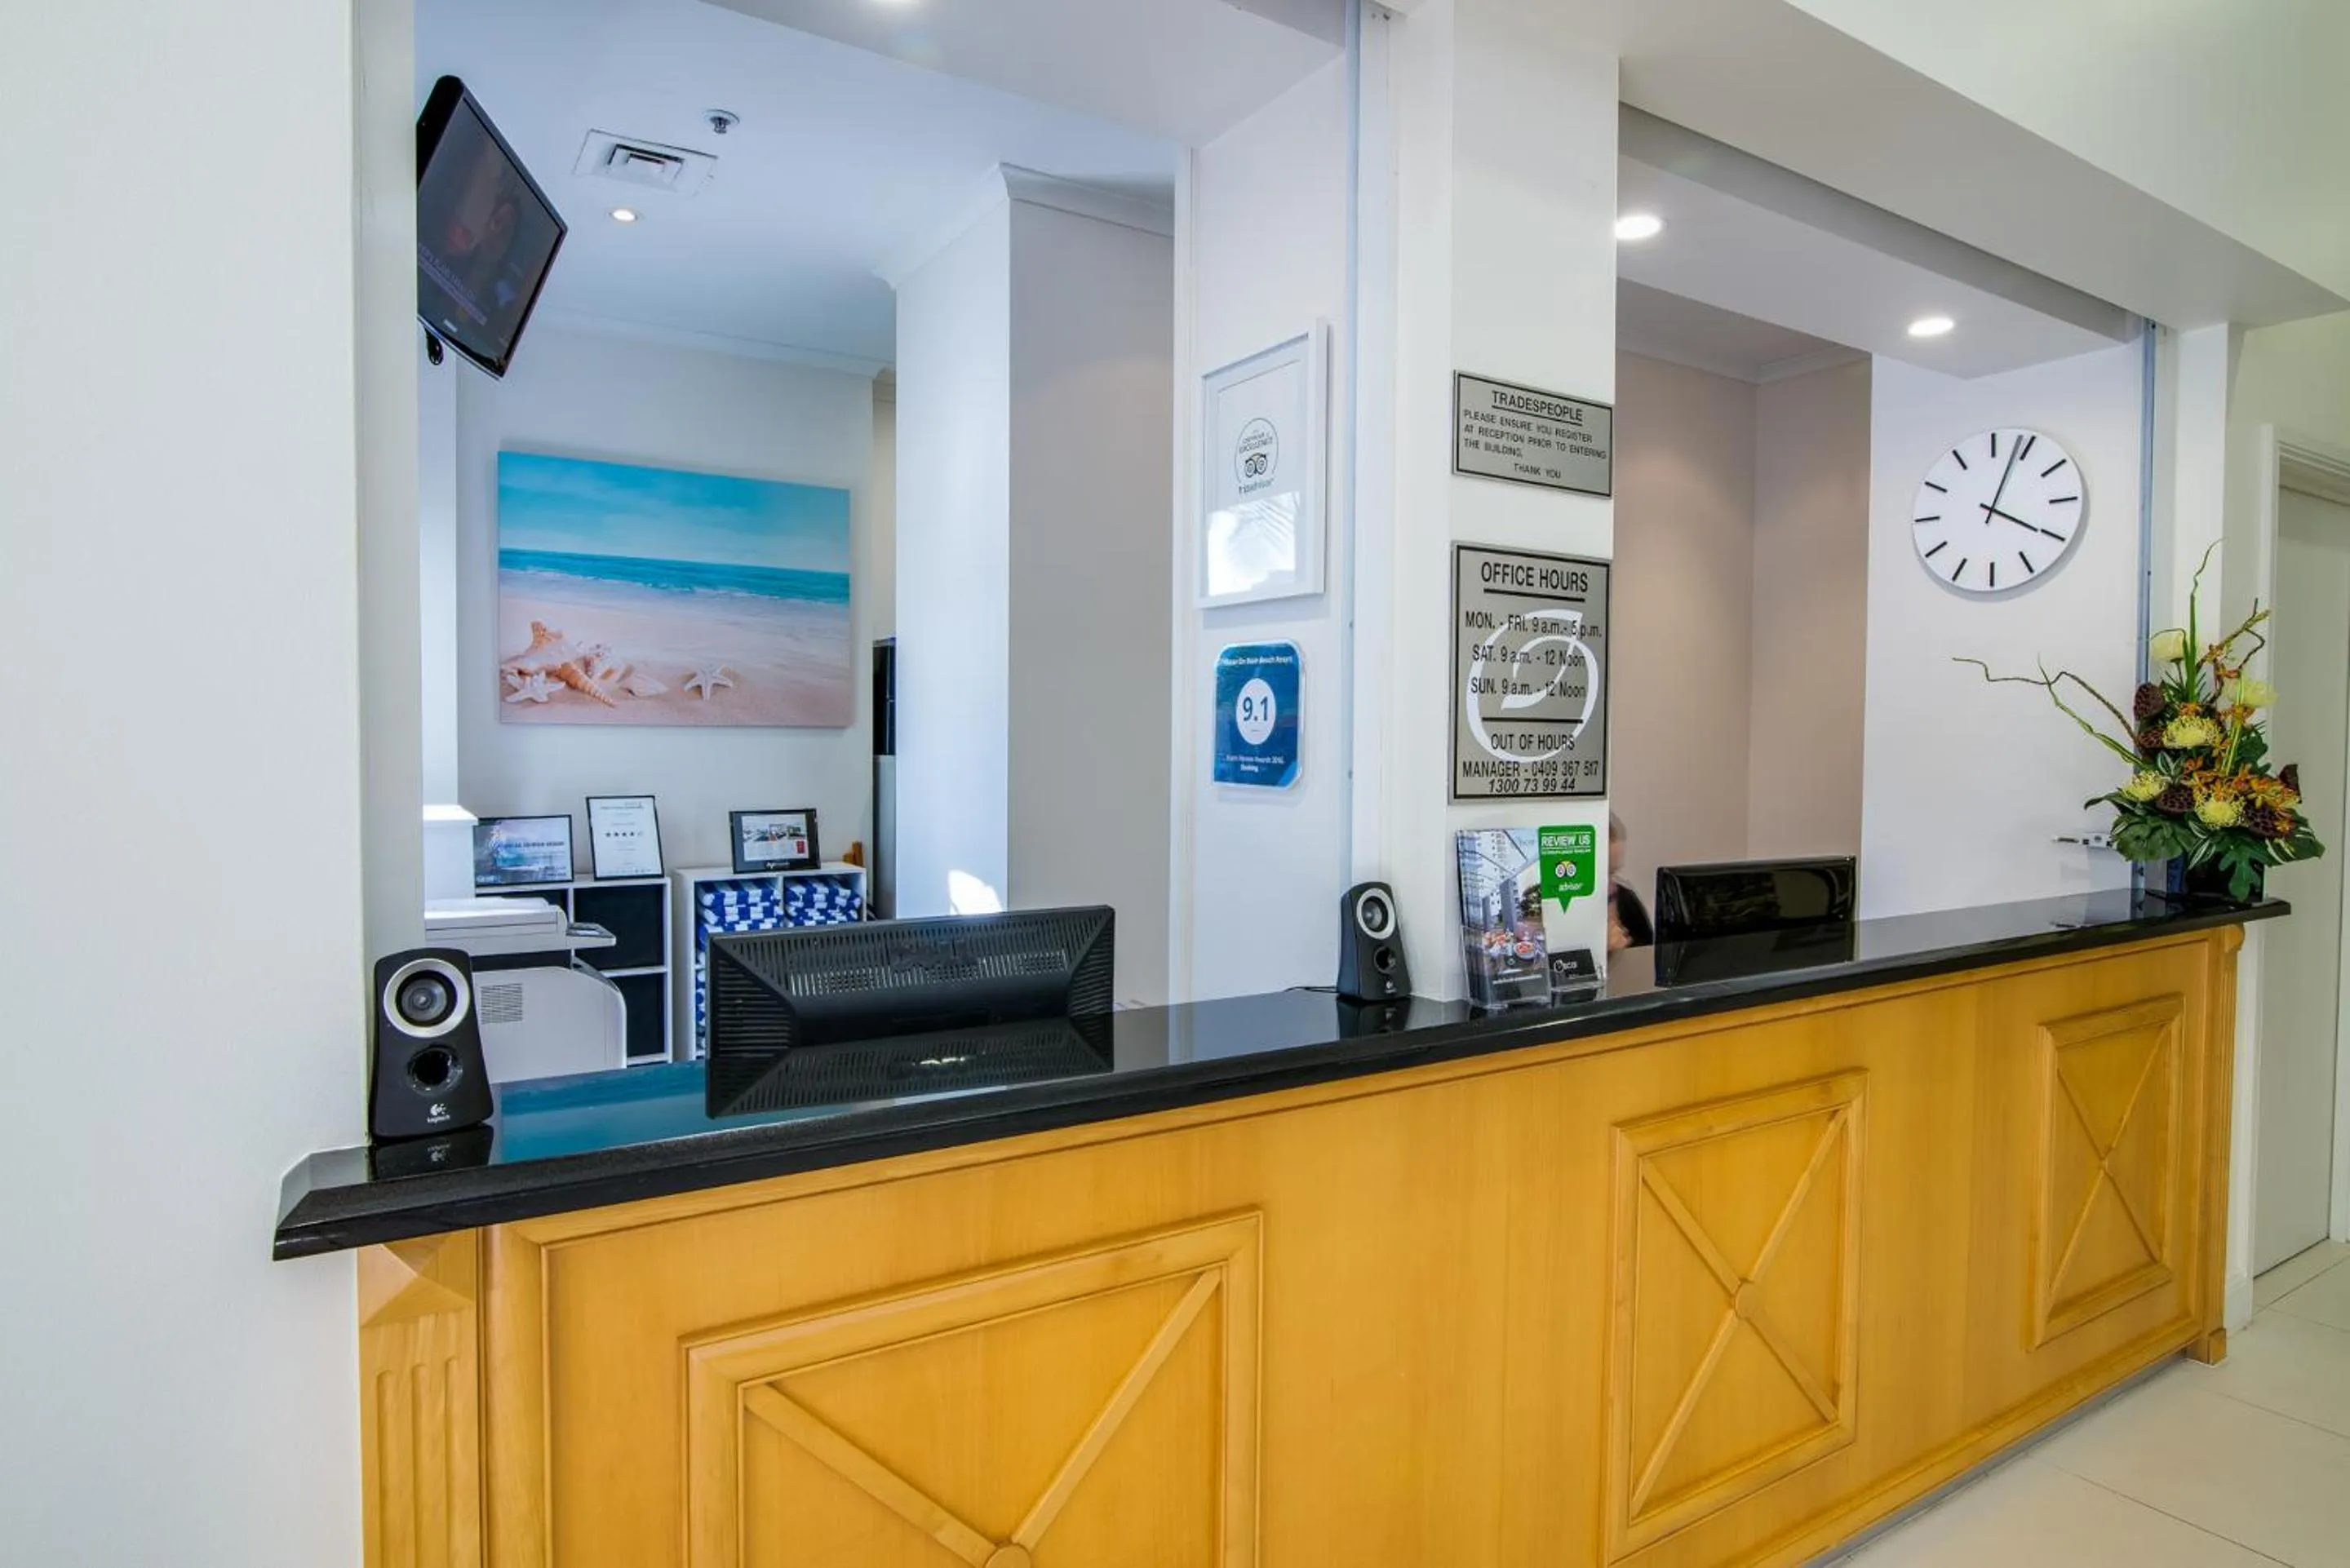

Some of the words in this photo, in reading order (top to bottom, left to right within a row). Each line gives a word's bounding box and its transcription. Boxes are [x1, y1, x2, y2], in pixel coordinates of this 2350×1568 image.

[1492, 391, 1583, 422] TRADESPEOPLE
[1465, 410, 1496, 423] PLEASE
[1500, 416, 1532, 431] ENSURE
[1536, 424, 1551, 436] YOU
[1555, 426, 1593, 443] REGISTER
[1464, 424, 1474, 433] AT
[1479, 426, 1525, 443] RECEPTION
[1528, 436, 1552, 450] PRIOR
[1556, 441, 1566, 451] TO
[1569, 444, 1607, 459] ENTERING
[1464, 438, 1479, 449] THE
[1514, 463, 1541, 476] THANK
[1545, 469, 1561, 479] YOU
[1481, 561, 1534, 587] OFFICE
[1539, 568, 1588, 593] HOURS
[1465, 611, 1496, 629] MON.
[1508, 613, 1528, 632] FRI.
[1532, 617, 1538, 632] 9
[1472, 644, 1496, 662] SAT.
[1500, 646, 1507, 662] 9
[1545, 649, 1555, 665] 12
[1559, 650, 1585, 667] Noon
[1470, 676, 1496, 693] SUN.
[1501, 680, 1508, 694] 9
[1545, 681, 1555, 696] 12
[1559, 682, 1585, 698] Noon
[1243, 697, 1268, 722] 9.1
[1491, 733, 1514, 750] OUT
[1519, 734, 1534, 750] OF
[1537, 734, 1575, 751] HOURS
[1462, 761, 1520, 777] MANAGER
[1488, 778, 1519, 793] 1300
[1524, 779, 1538, 792] 73
[1542, 778, 1557, 792] 99
[1560, 778, 1576, 791] 44
[1541, 835, 1576, 847] REVIEW
[1579, 833, 1591, 845] US
